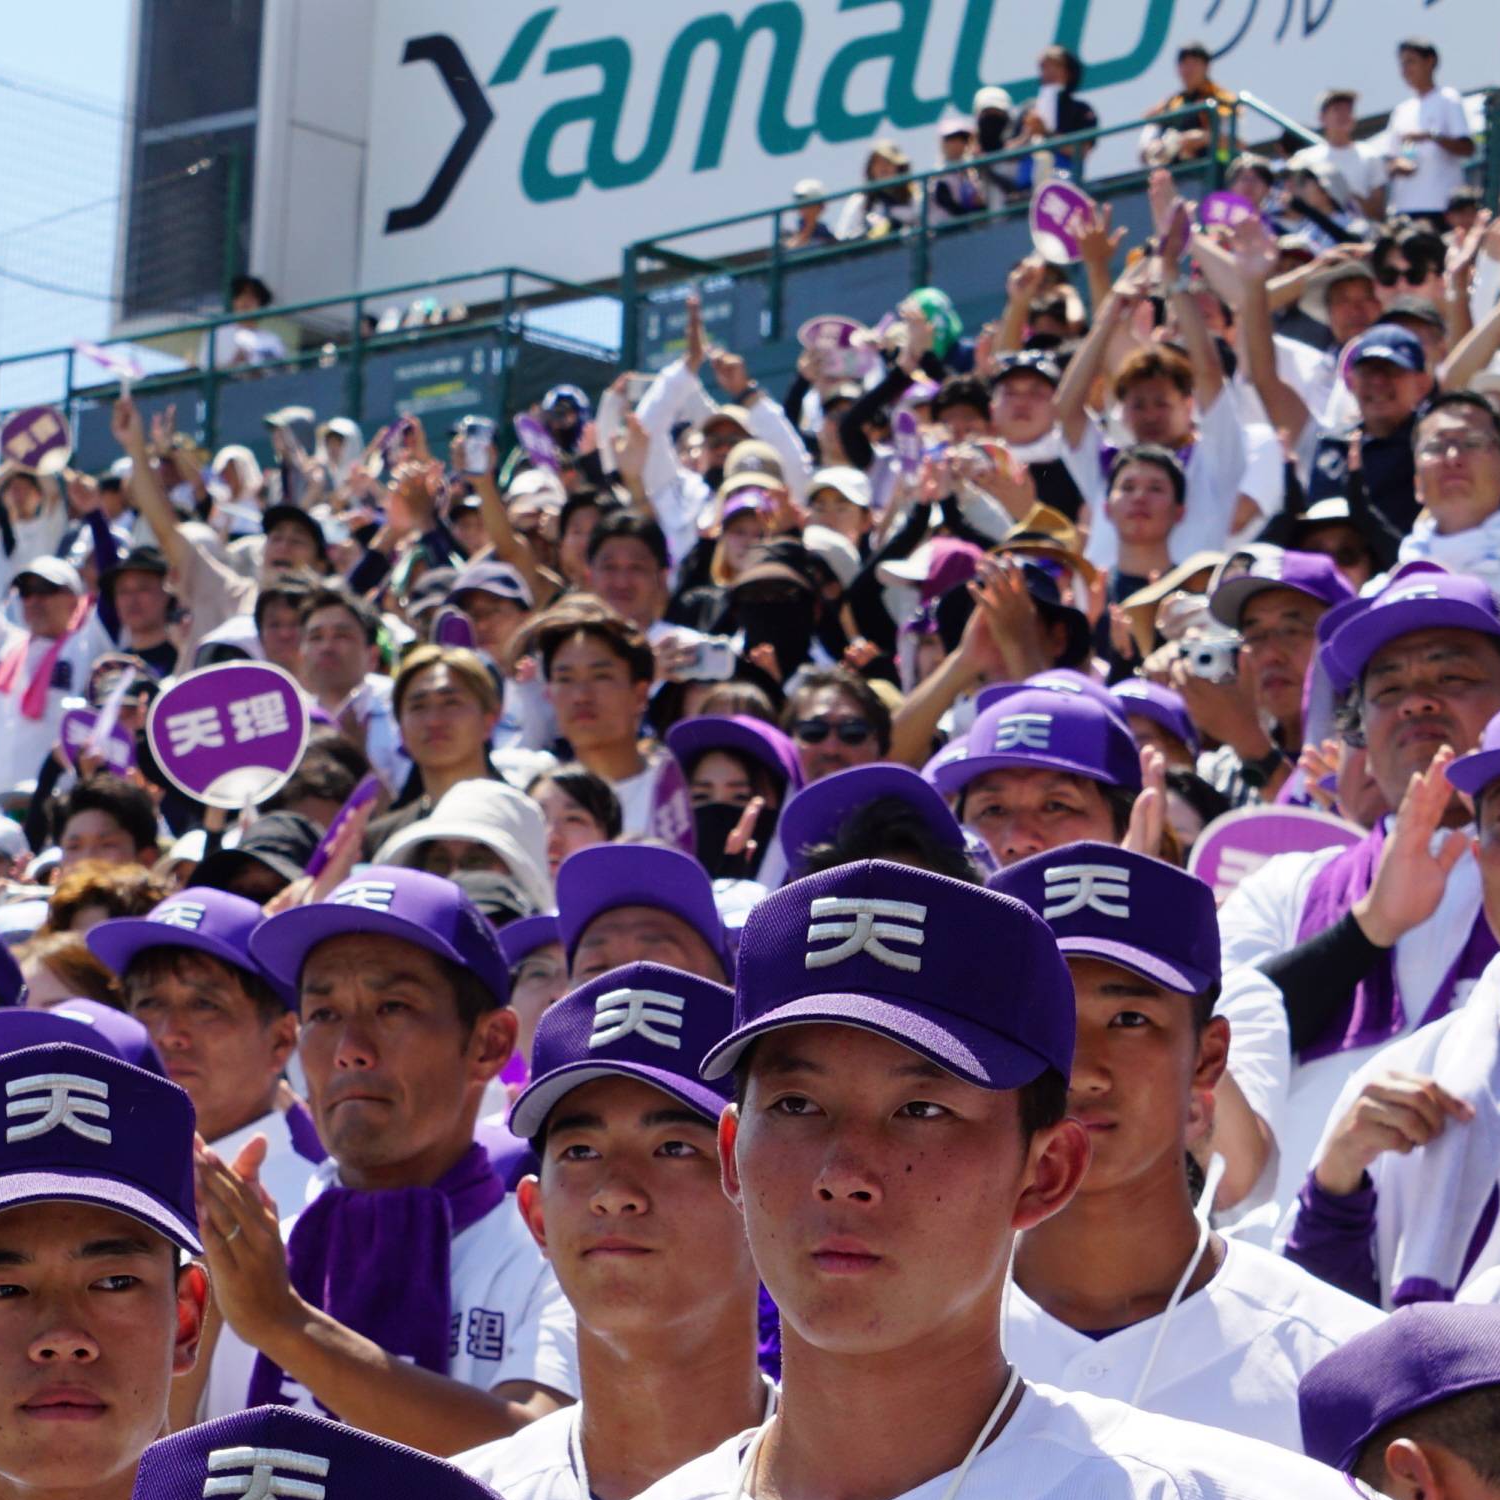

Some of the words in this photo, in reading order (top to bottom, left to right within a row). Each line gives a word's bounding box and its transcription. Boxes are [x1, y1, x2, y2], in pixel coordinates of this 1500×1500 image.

[165, 690, 290, 758] 天理
[994, 712, 1053, 751] 天
[1043, 864, 1131, 920] 天
[805, 896, 927, 973] 天
[588, 988, 686, 1050] 天
[5, 1073, 112, 1146] 天
